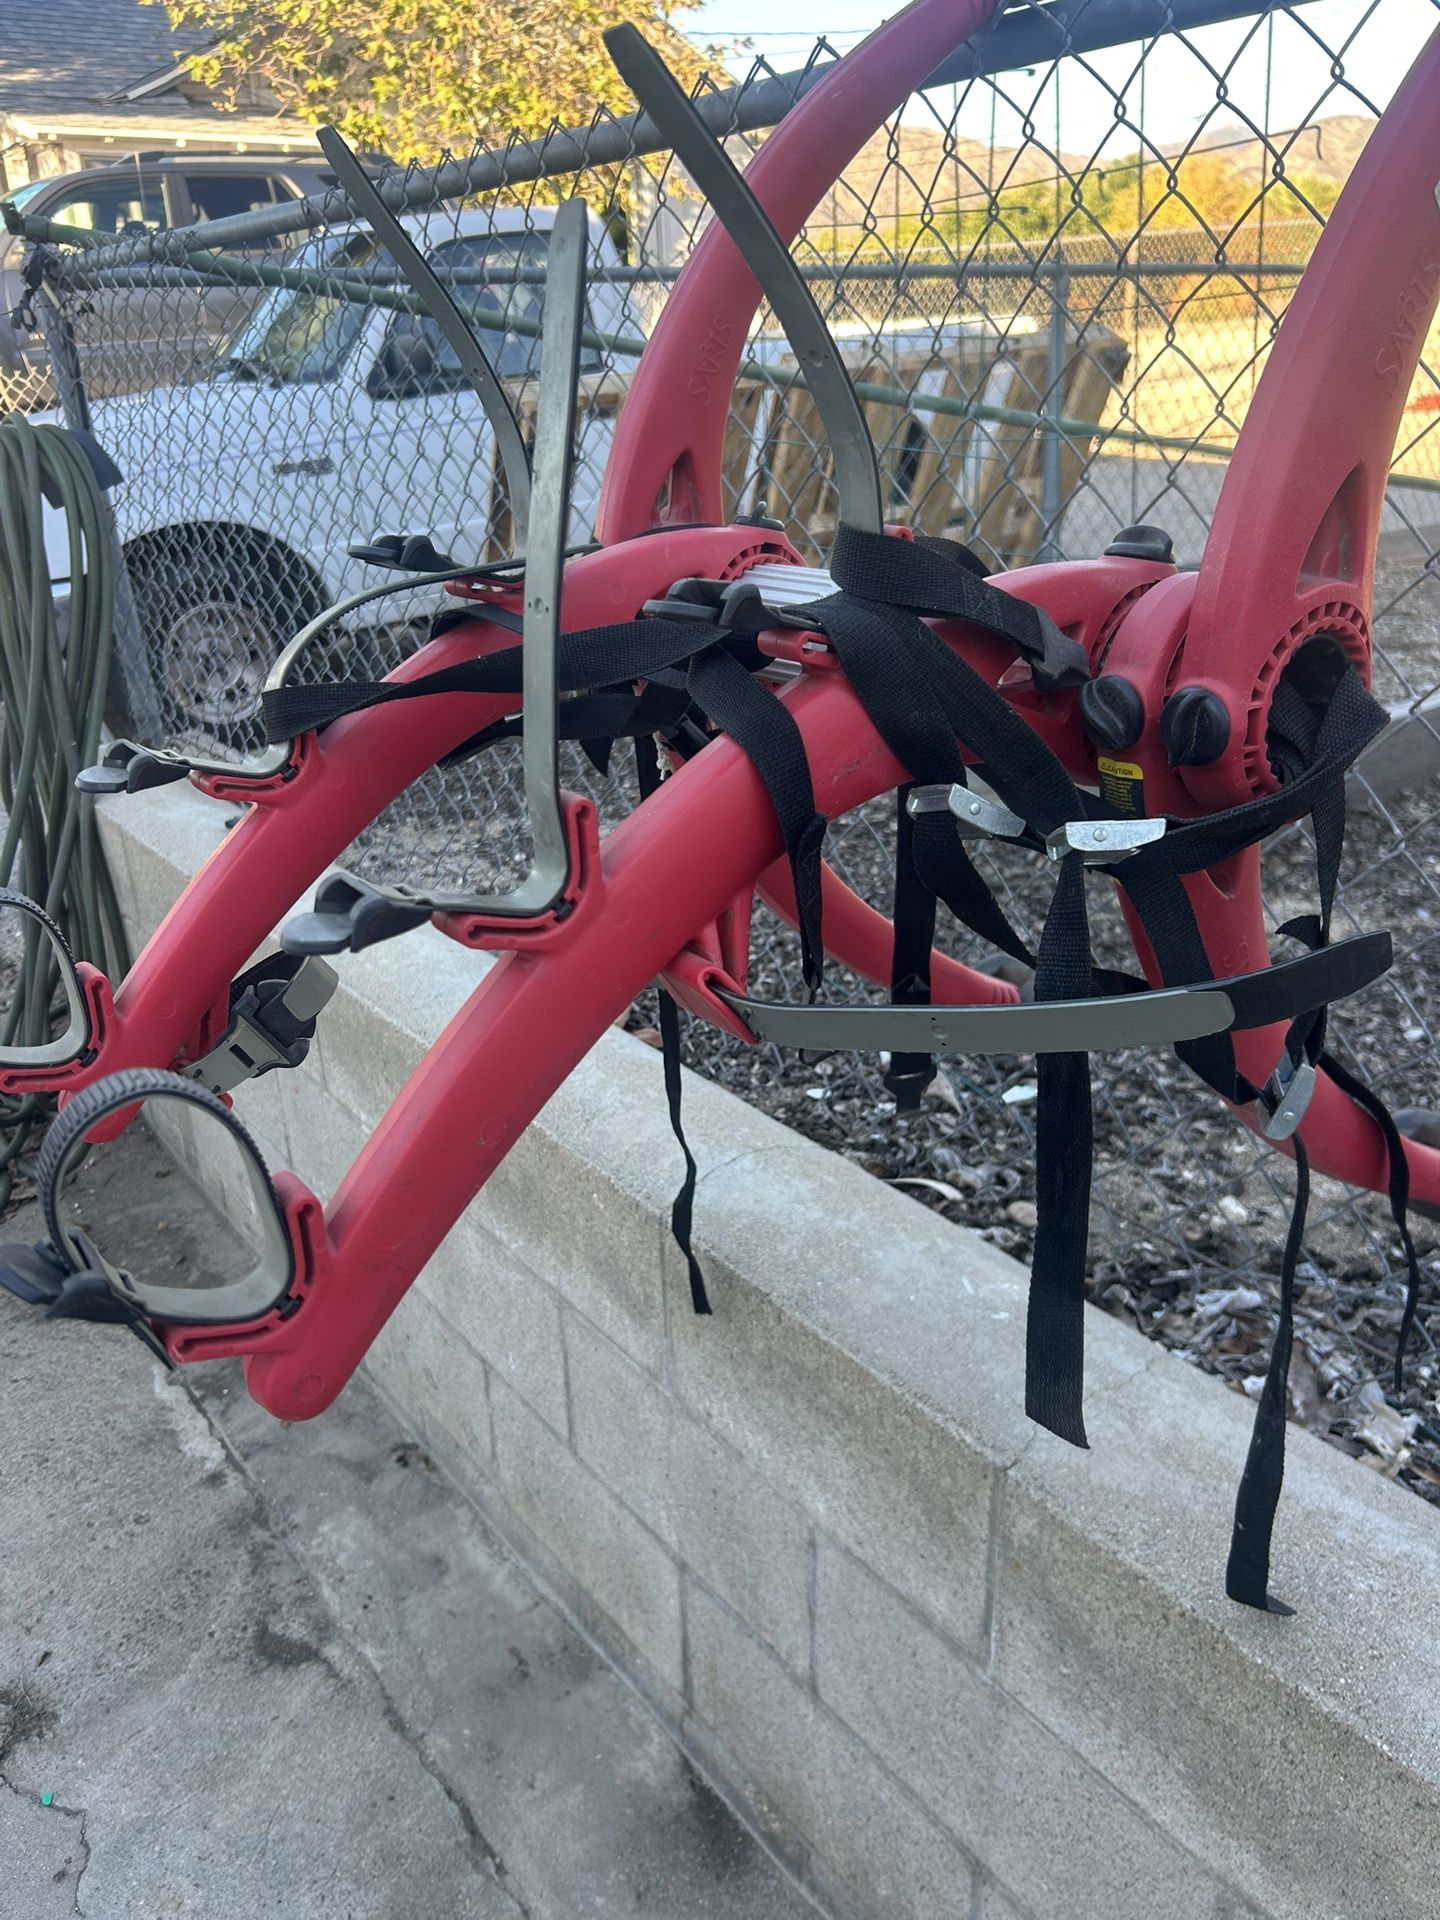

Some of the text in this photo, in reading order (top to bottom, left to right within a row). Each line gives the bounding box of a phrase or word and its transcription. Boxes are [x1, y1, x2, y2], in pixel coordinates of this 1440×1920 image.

[689, 315, 734, 407] SARIS
[1375, 250, 1440, 398] SARIS
[1105, 765, 1133, 776] CAUTION
